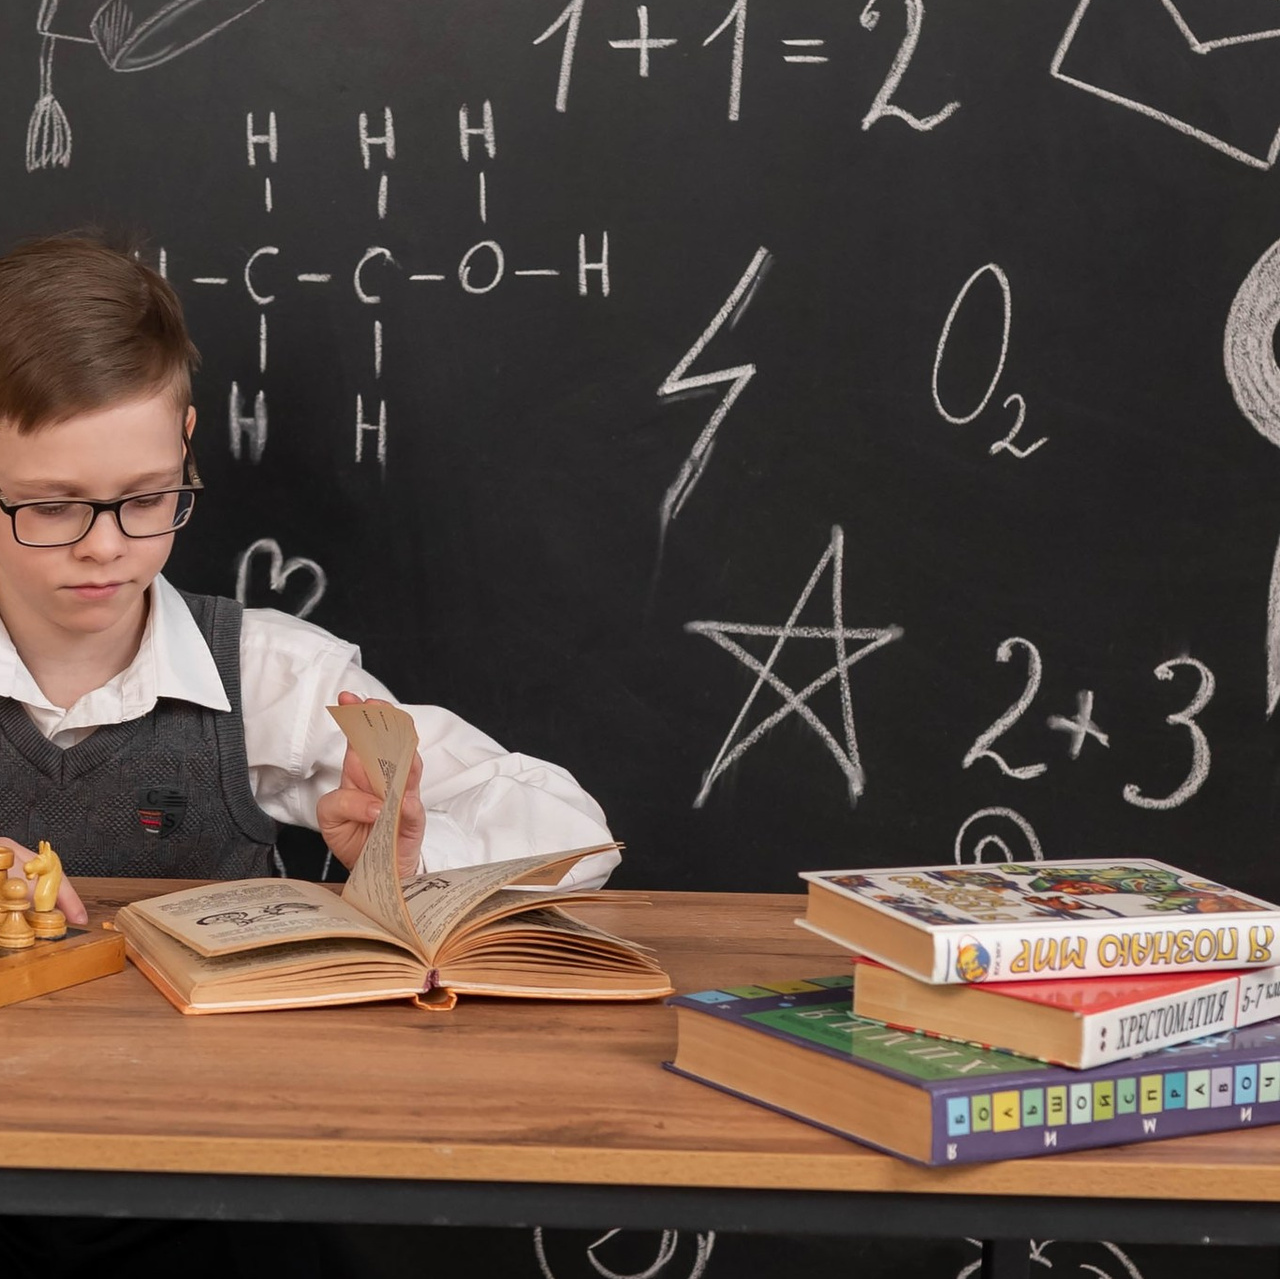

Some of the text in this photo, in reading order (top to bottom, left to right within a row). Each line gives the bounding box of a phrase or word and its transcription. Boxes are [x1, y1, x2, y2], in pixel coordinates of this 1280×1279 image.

[1009, 935, 1090, 974] МИР
[1097, 927, 1239, 968] ПОЗНАЮ
[1246, 925, 1276, 964] Я
[1116, 990, 1230, 1051] ХРЕСТОМАТИЯ
[1241, 985, 1266, 1013] 5-7
